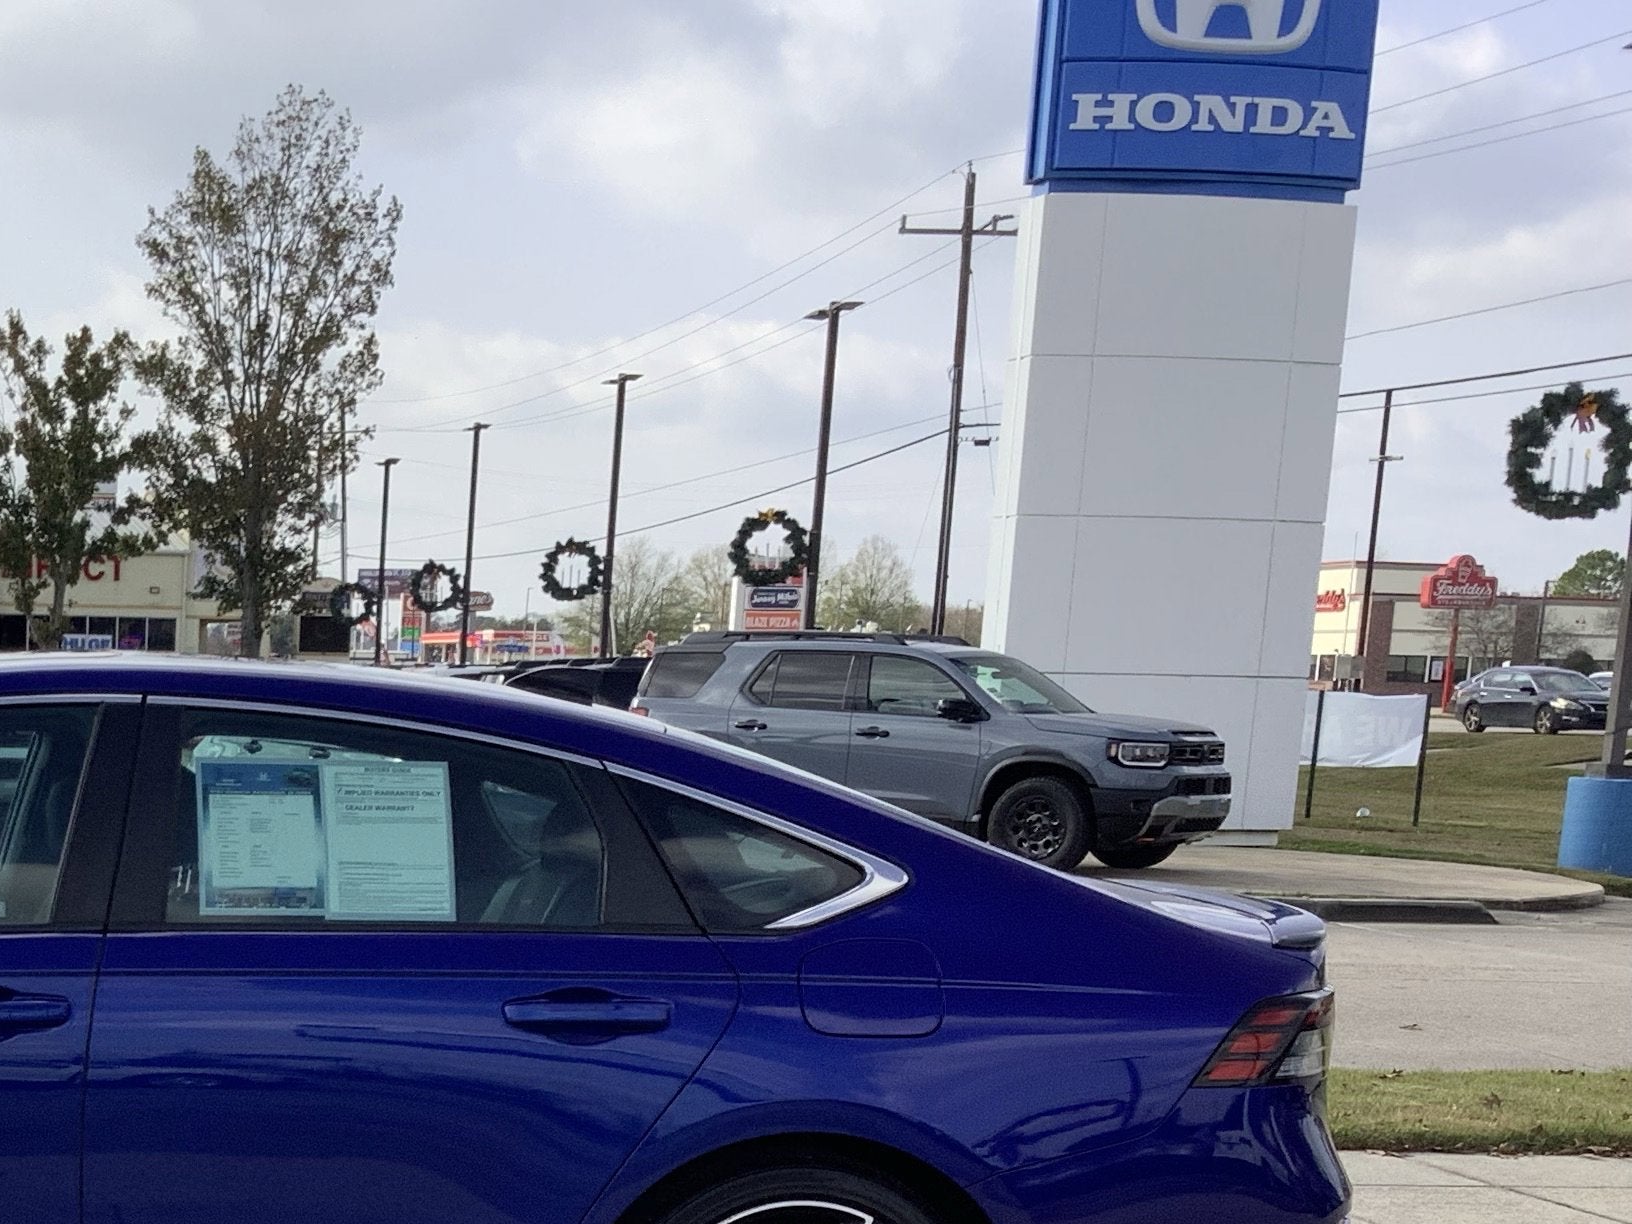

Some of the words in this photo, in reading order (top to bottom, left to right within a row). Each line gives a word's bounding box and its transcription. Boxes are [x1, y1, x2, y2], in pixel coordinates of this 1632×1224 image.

[1069, 92, 1356, 140] HONDA
[1433, 579, 1493, 597] Freddy's
[769, 616, 790, 628] PIZZA
[374, 789, 421, 797] WARRANTIES
[421, 790, 441, 798] ONLY
[375, 804, 415, 812] WARRANTY
